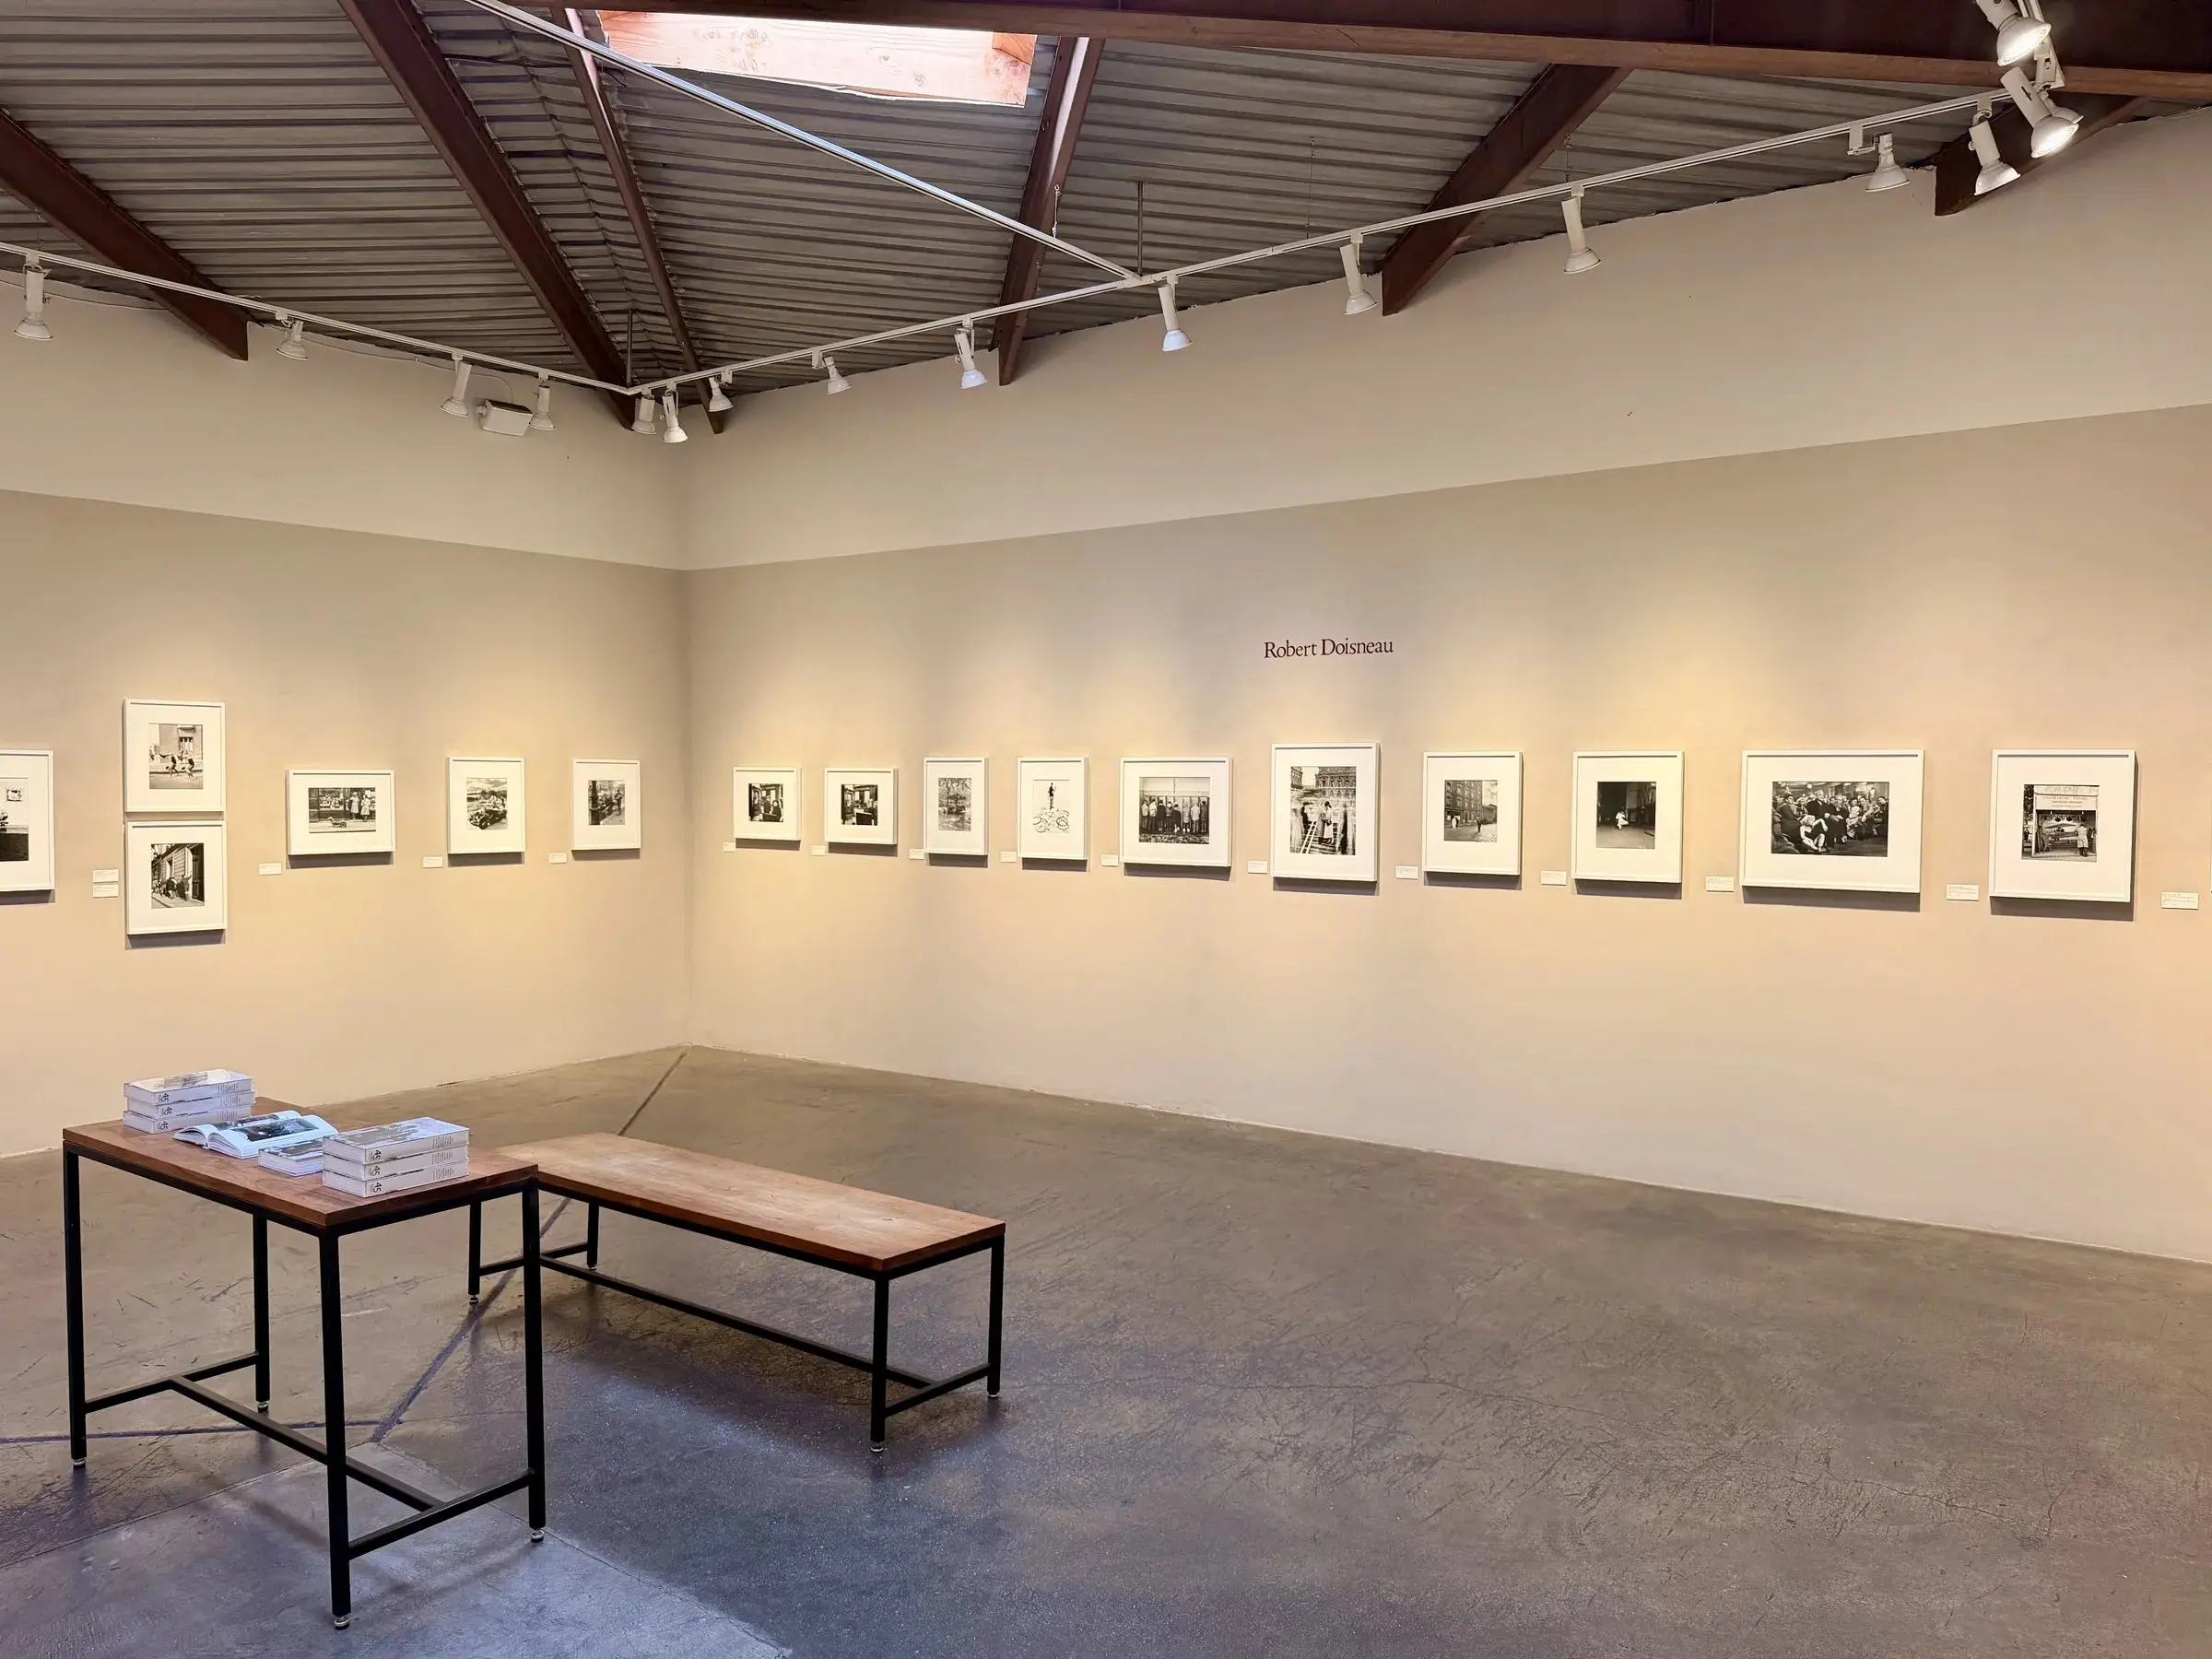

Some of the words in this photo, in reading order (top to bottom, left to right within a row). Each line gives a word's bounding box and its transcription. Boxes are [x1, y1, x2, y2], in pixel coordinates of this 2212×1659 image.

[1264, 640, 1317, 658] Robert
[1321, 638, 1394, 655] Doisneau
[372, 1149, 382, 1160] 45
[371, 1165, 381, 1176] 45
[372, 1182, 382, 1194] 45
